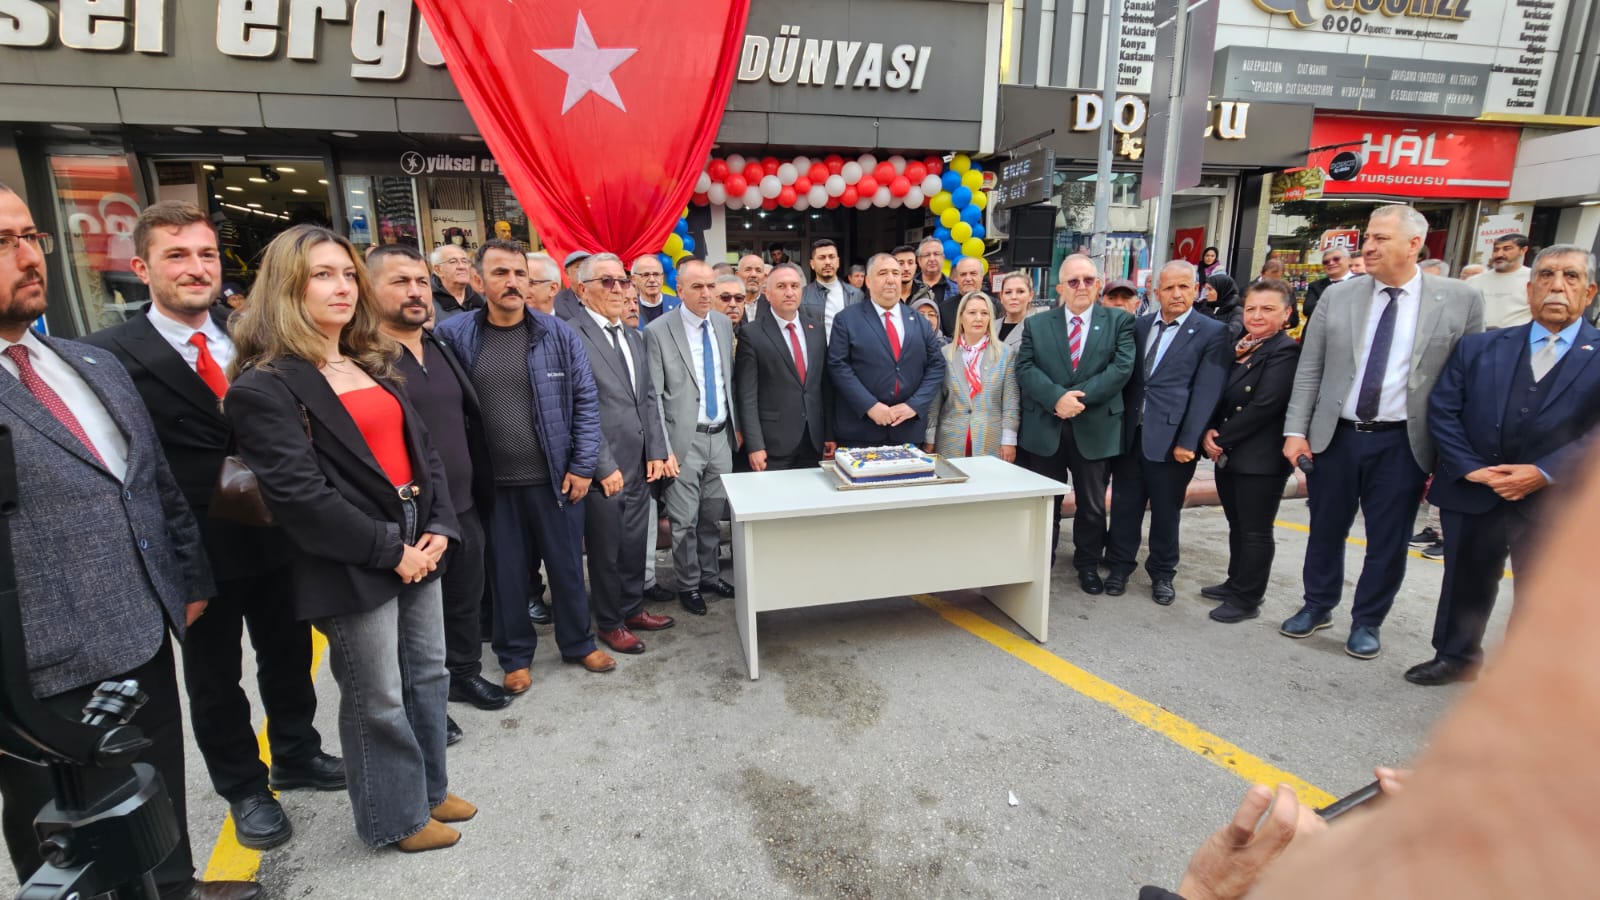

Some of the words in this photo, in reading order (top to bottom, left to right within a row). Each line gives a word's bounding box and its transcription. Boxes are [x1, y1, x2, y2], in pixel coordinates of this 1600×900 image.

[1120, 38, 1146, 50] Konya
[737, 25, 932, 90] DÜNYASI
[1118, 62, 1142, 75] Sinop
[1073, 93, 1251, 139] DOU
[426, 154, 476, 174] yüksel
[1359, 173, 1445, 186] TURŞUCUSU
